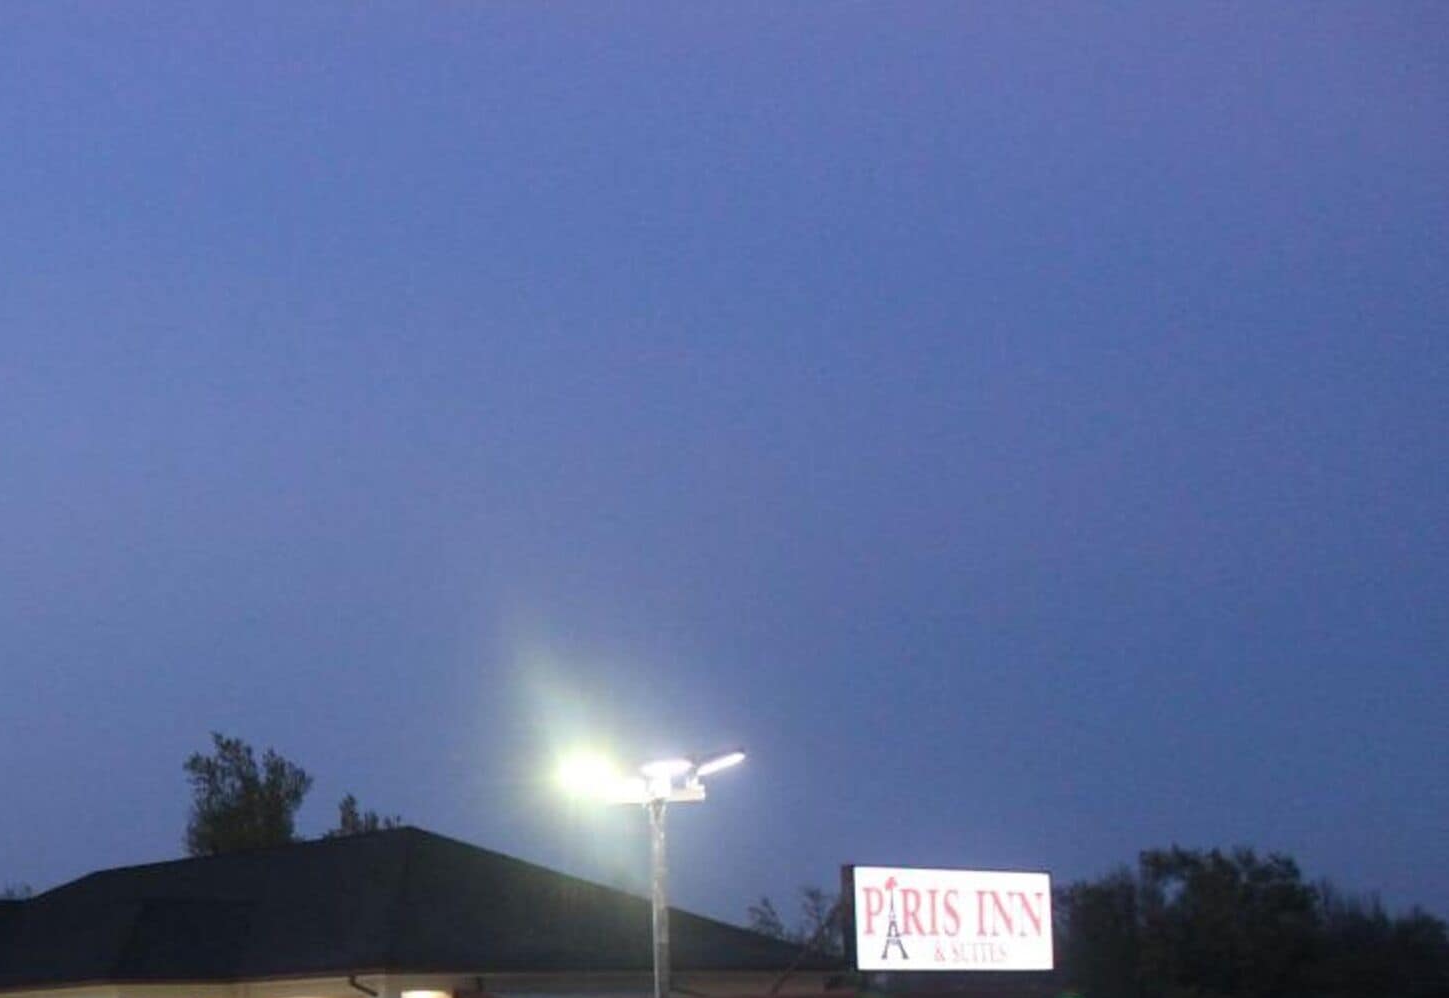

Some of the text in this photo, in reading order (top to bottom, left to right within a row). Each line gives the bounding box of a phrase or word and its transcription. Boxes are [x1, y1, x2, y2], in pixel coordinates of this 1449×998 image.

[862, 880, 1044, 959] PARIS INN
[933, 941, 1008, 963] & SUITES
